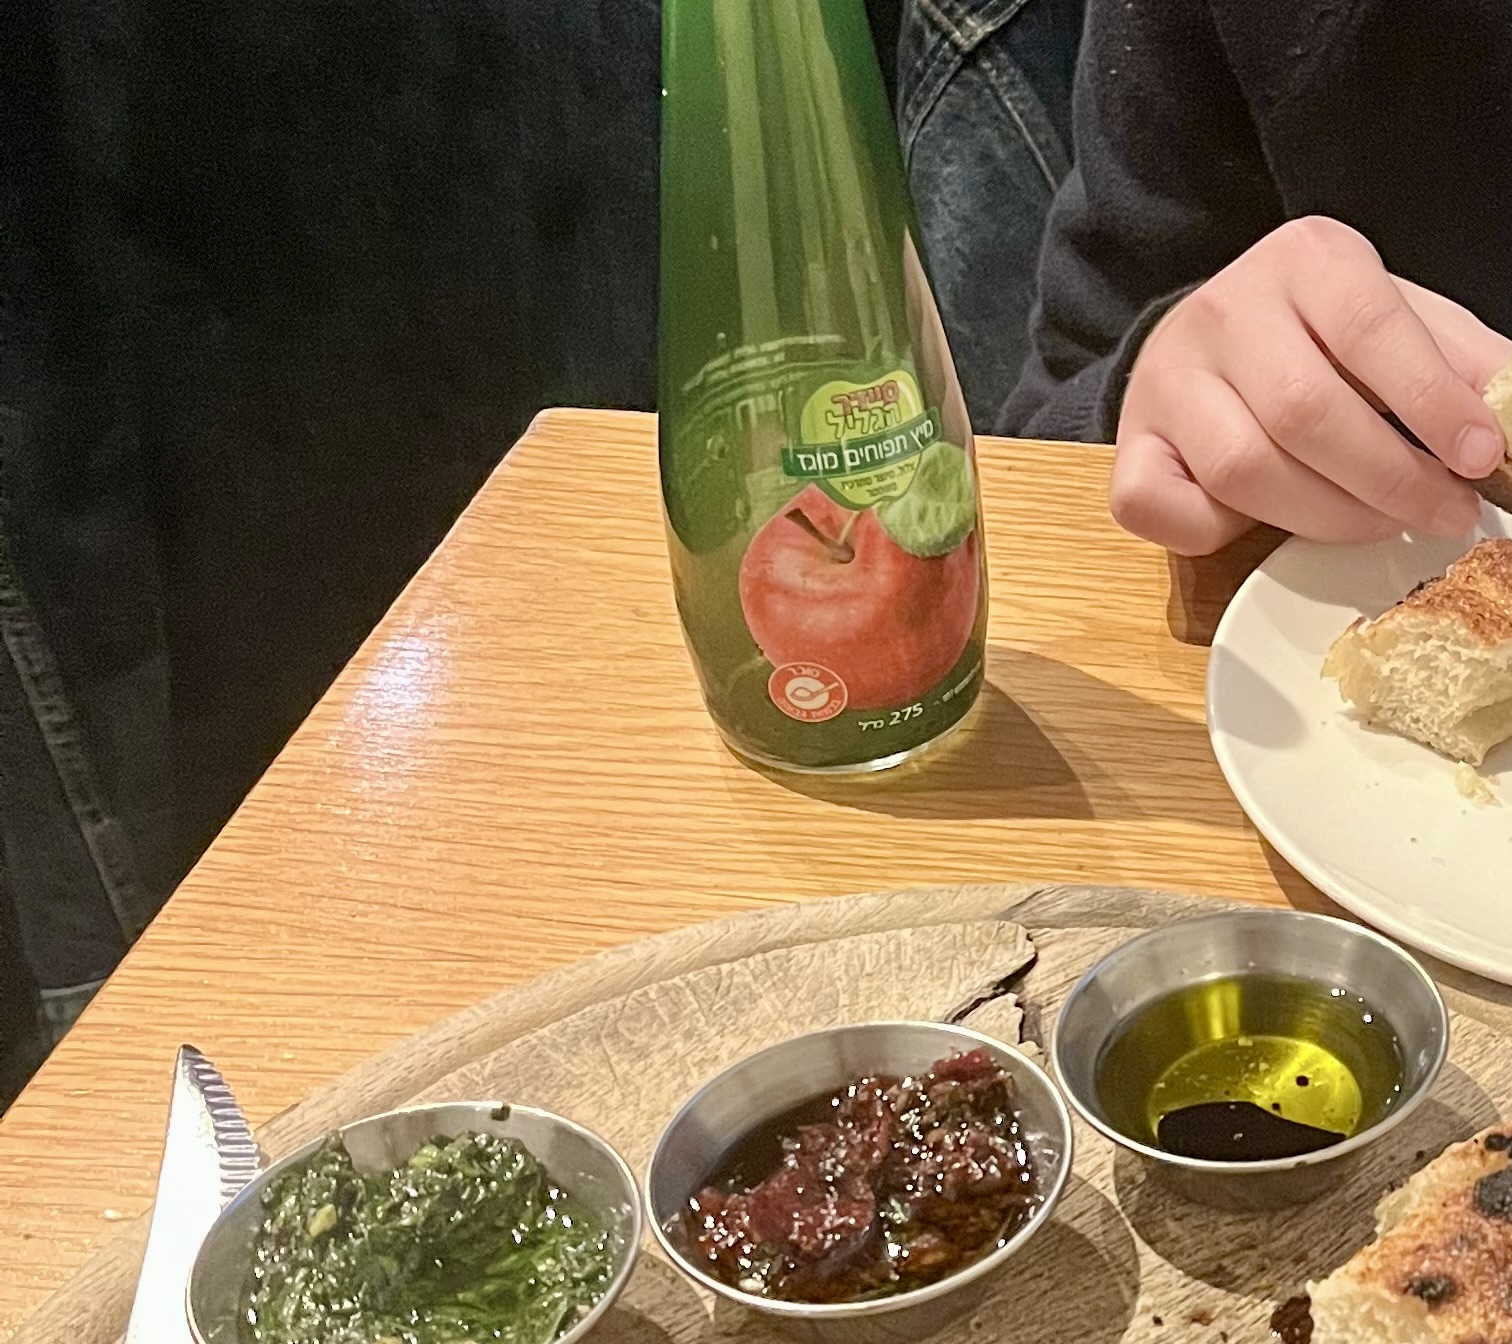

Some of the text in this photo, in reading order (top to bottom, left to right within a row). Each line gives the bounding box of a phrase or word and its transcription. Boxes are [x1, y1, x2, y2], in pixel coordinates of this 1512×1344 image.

[797, 420, 934, 471] מיץ תפוחים מוגז
[889, 703, 923, 726] 275
